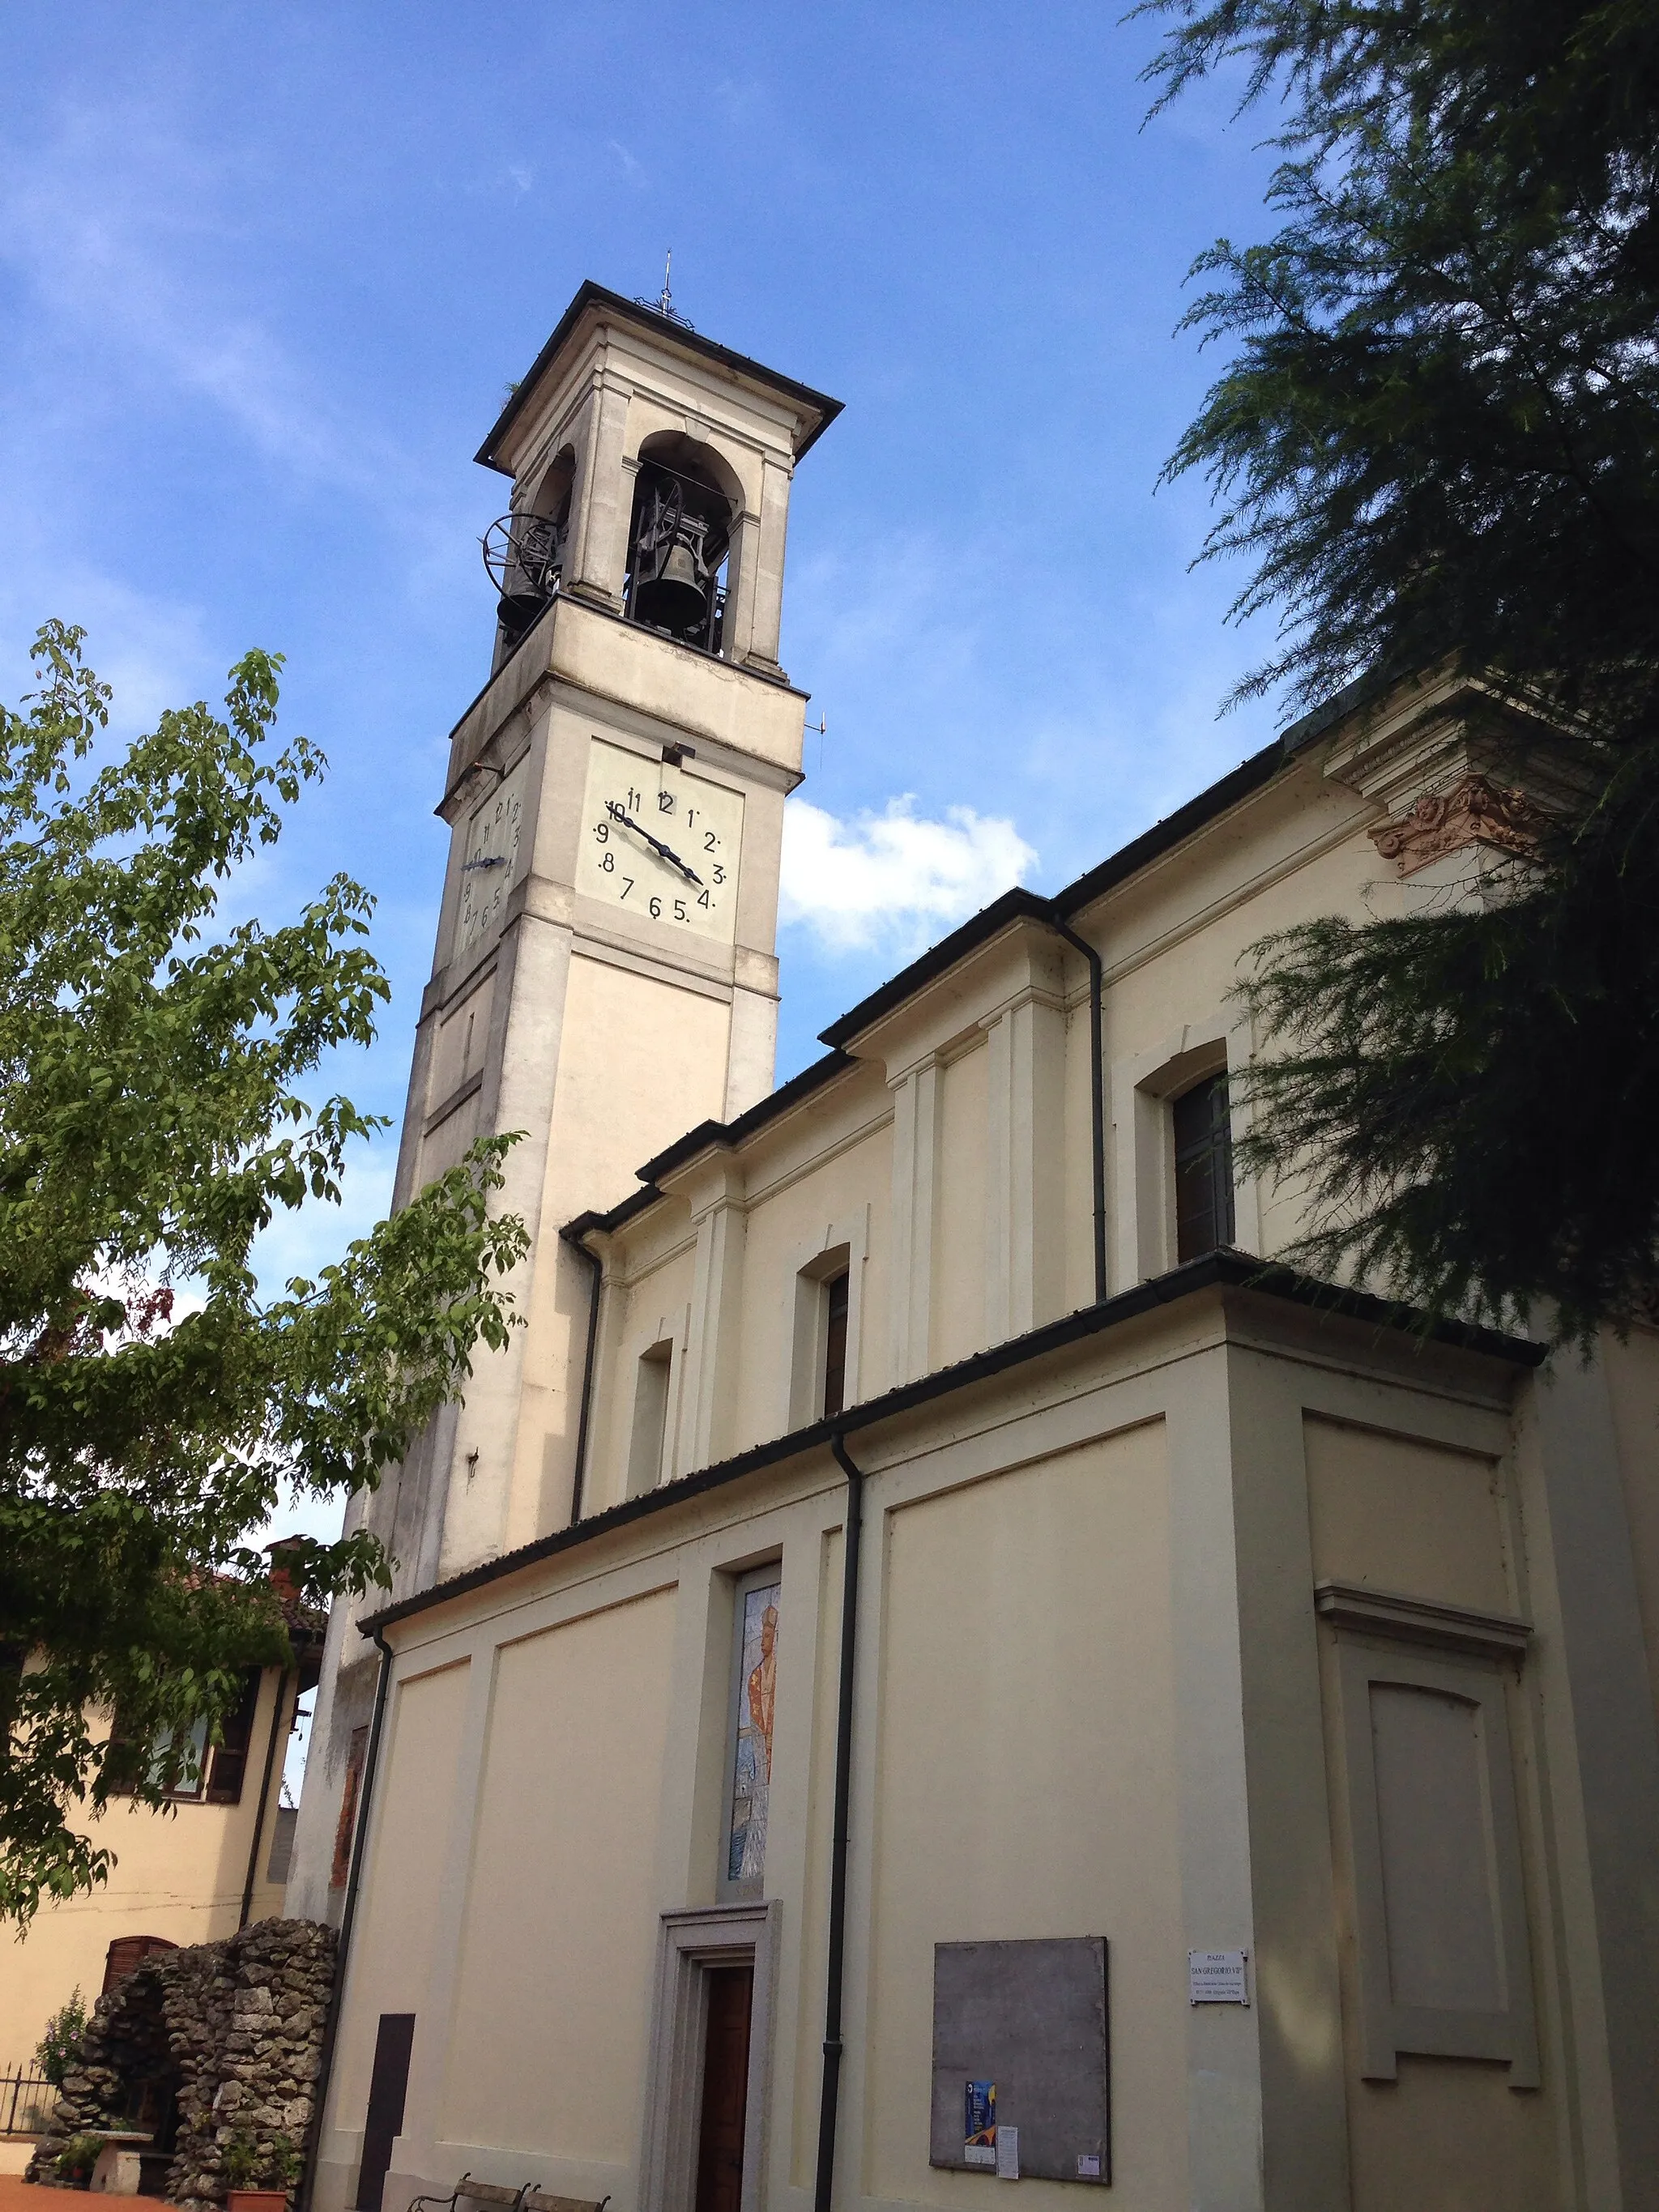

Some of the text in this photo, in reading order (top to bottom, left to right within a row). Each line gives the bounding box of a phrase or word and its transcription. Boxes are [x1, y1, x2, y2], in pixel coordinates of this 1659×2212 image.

[607, 800, 625, 823] 10
[628, 790, 642, 812] 11
[658, 791, 674, 815] 12
[511, 802, 518, 824] 2
[688, 809, 694, 828] 1
[514, 825, 521, 847] 3
[595, 823, 609, 844] 9
[703, 831, 716, 853] 2
[505, 859, 512, 879] 4
[603, 853, 615, 872] 8
[712, 863, 724, 884] 3
[464, 883, 471, 902] 9
[620, 876, 634, 899] 7
[493, 888, 500, 910] 5
[649, 897, 662, 918] 6
[674, 899, 686, 921] 5
[697, 889, 709, 910] 4
[464, 903, 471, 923] 8
[470, 910, 477, 936] 7
[482, 906, 488, 928] 6
[1192, 1967, 1202, 1975] SAN
[1202, 1967, 1231, 1975] GREGORIO
